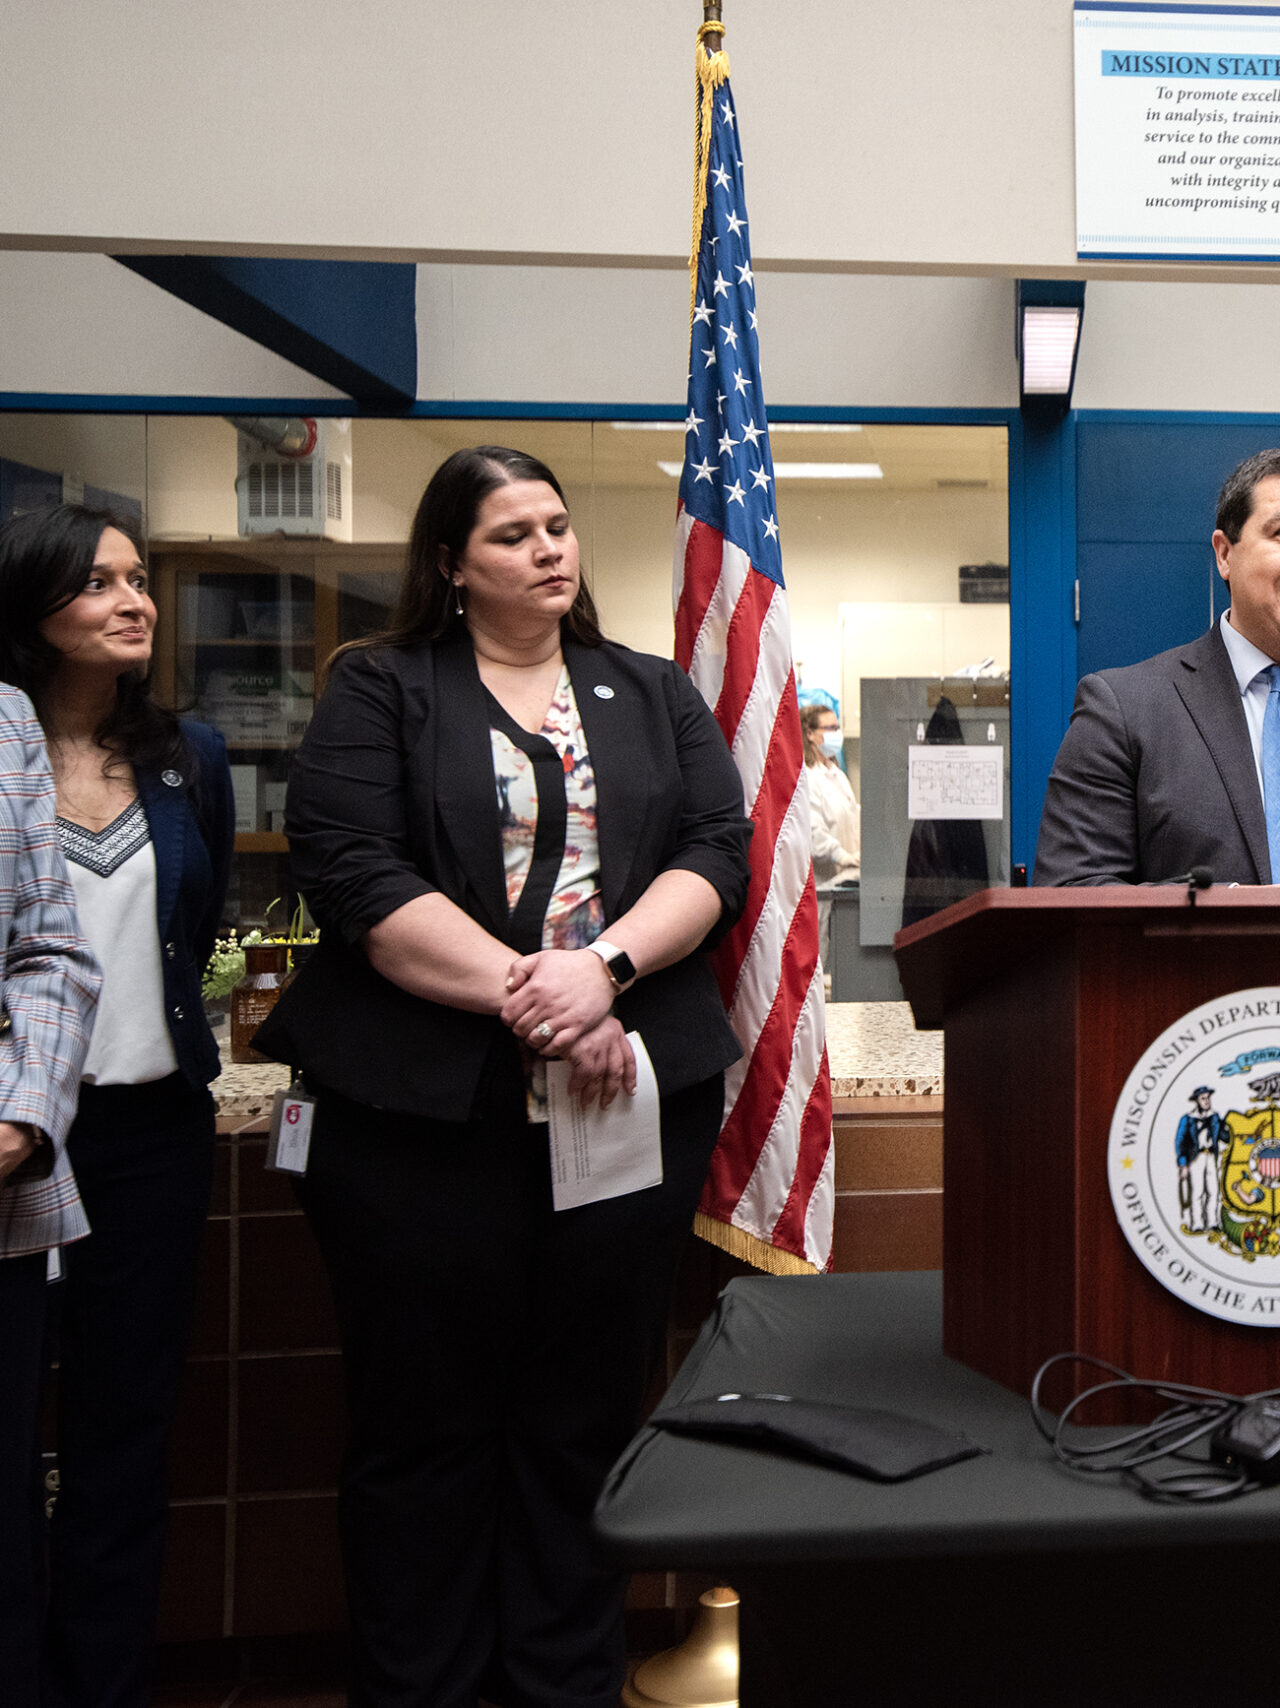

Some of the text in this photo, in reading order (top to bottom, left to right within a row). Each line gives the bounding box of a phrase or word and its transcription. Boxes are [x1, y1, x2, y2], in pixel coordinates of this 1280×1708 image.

[1111, 54, 1211, 75] MISSION
[1156, 87, 1173, 99] To
[1177, 89, 1237, 103] promote
[1146, 108, 1160, 121] in
[1165, 109, 1228, 125] analysis,
[1144, 130, 1195, 143] service
[1199, 133, 1213, 144] to
[1217, 131, 1239, 144] the
[1158, 151, 1186, 165] and
[1190, 154, 1216, 165] our
[1170, 173, 1202, 186] with
[1207, 174, 1269, 191] integrity
[1145, 196, 1267, 212] uncompromising
[1120, 1029, 1197, 1149] WISCONSIN
[1120, 1181, 1172, 1263] OFFICE
[1167, 1257, 1199, 1285] OF
[1200, 1277, 1246, 1311] THE
